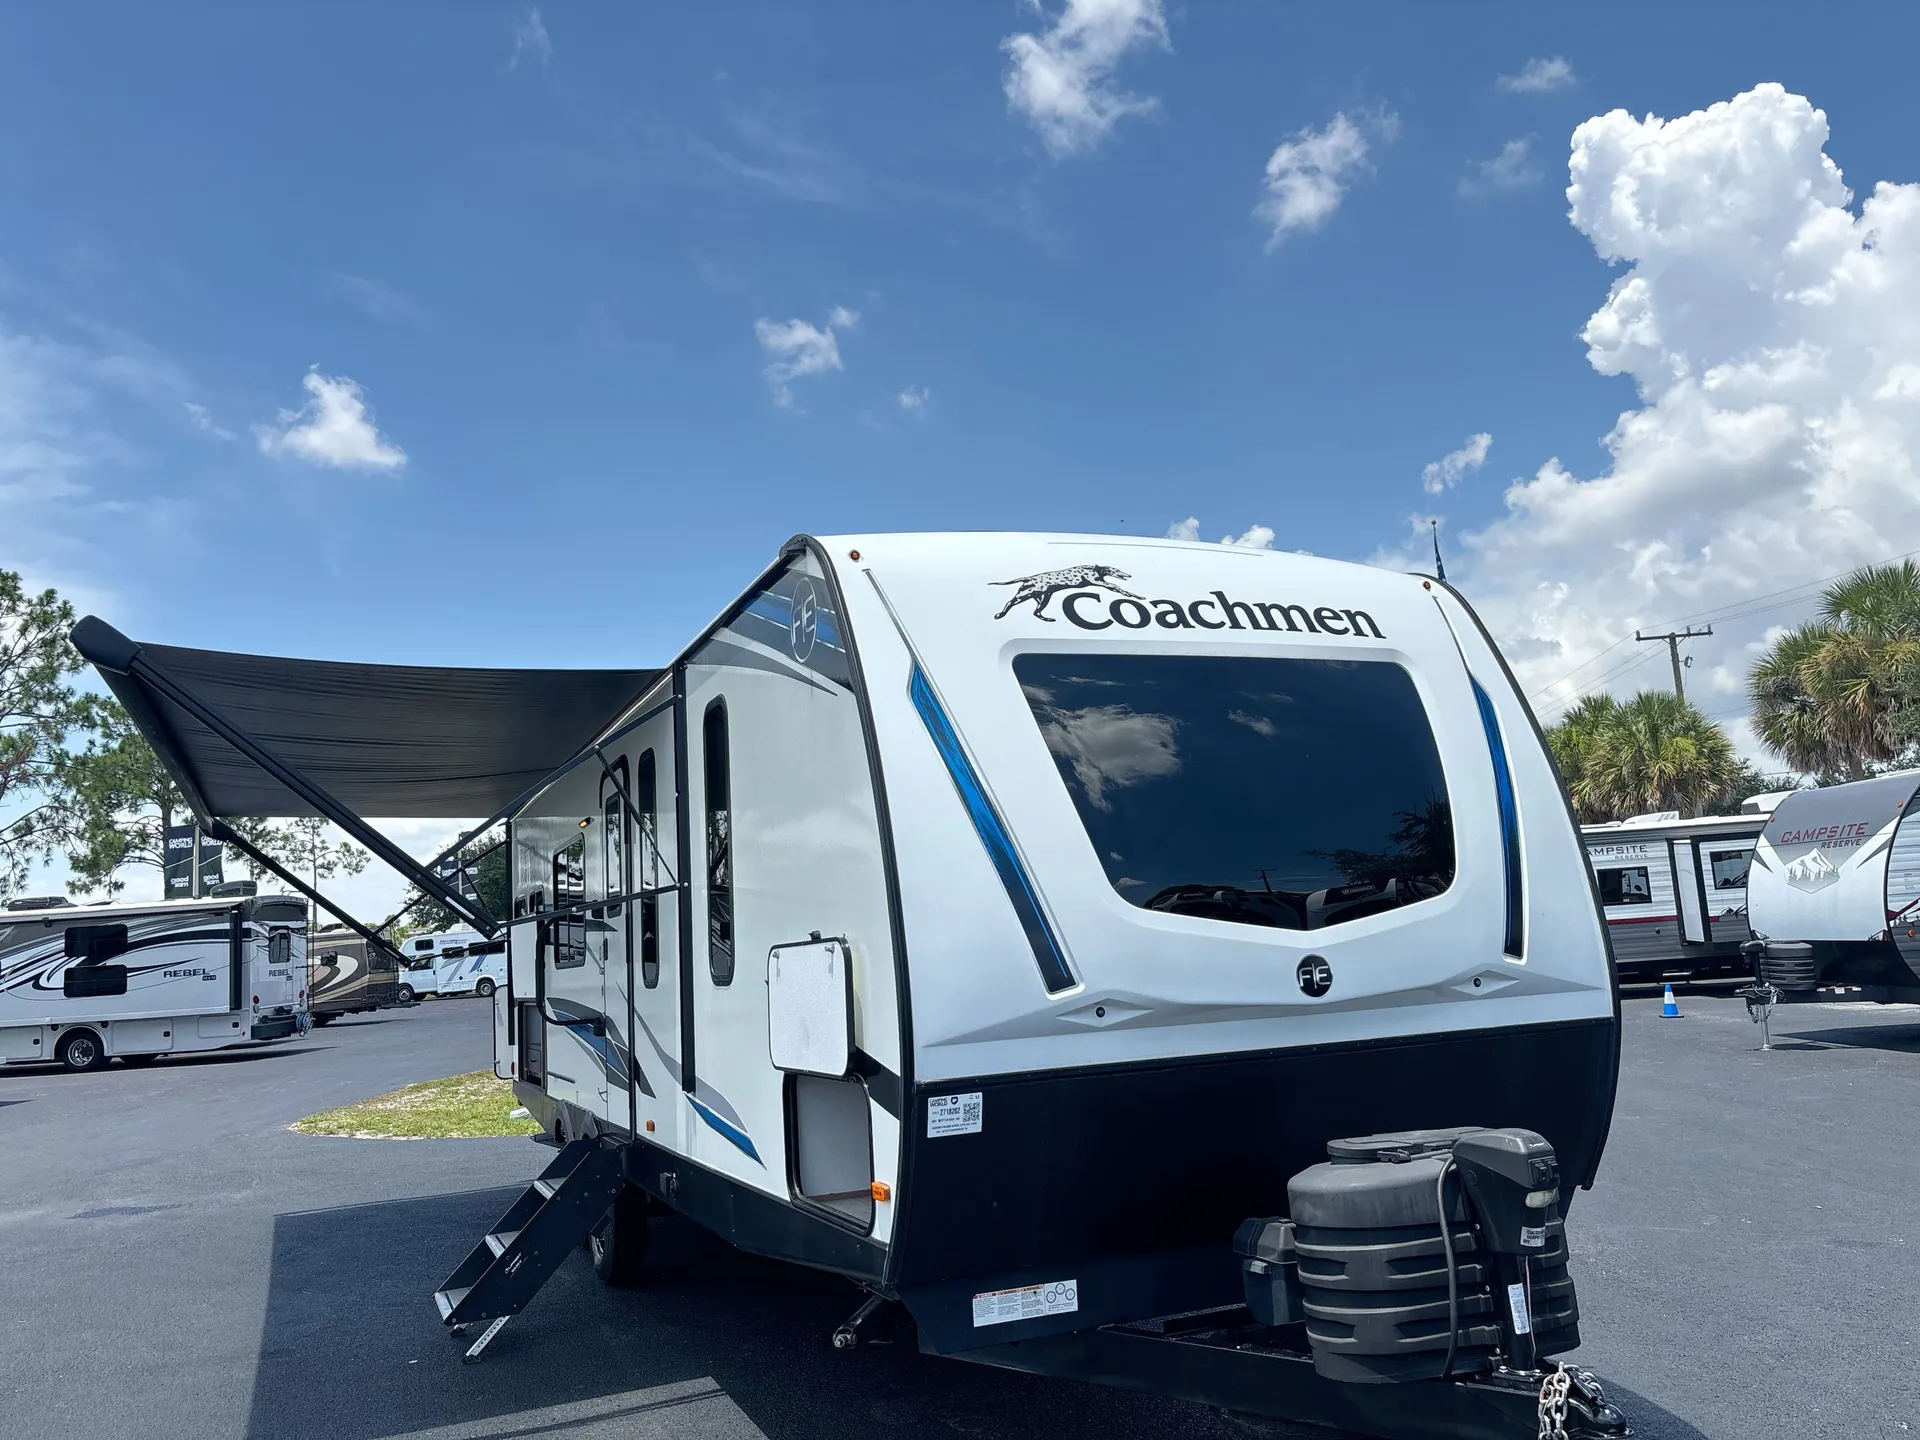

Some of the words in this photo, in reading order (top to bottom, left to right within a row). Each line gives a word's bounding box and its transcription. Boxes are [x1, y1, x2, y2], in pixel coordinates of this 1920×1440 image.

[1061, 591, 1387, 639] Coachmen
[1780, 822, 1869, 843] CAMPSITE
[1820, 839, 1862, 849] RESERVE
[1586, 845, 1648, 856] AMPSITE
[170, 875, 189, 884] good
[203, 873, 219, 882] good
[163, 968, 210, 978] REBEL
[268, 969, 290, 977] REBEL
